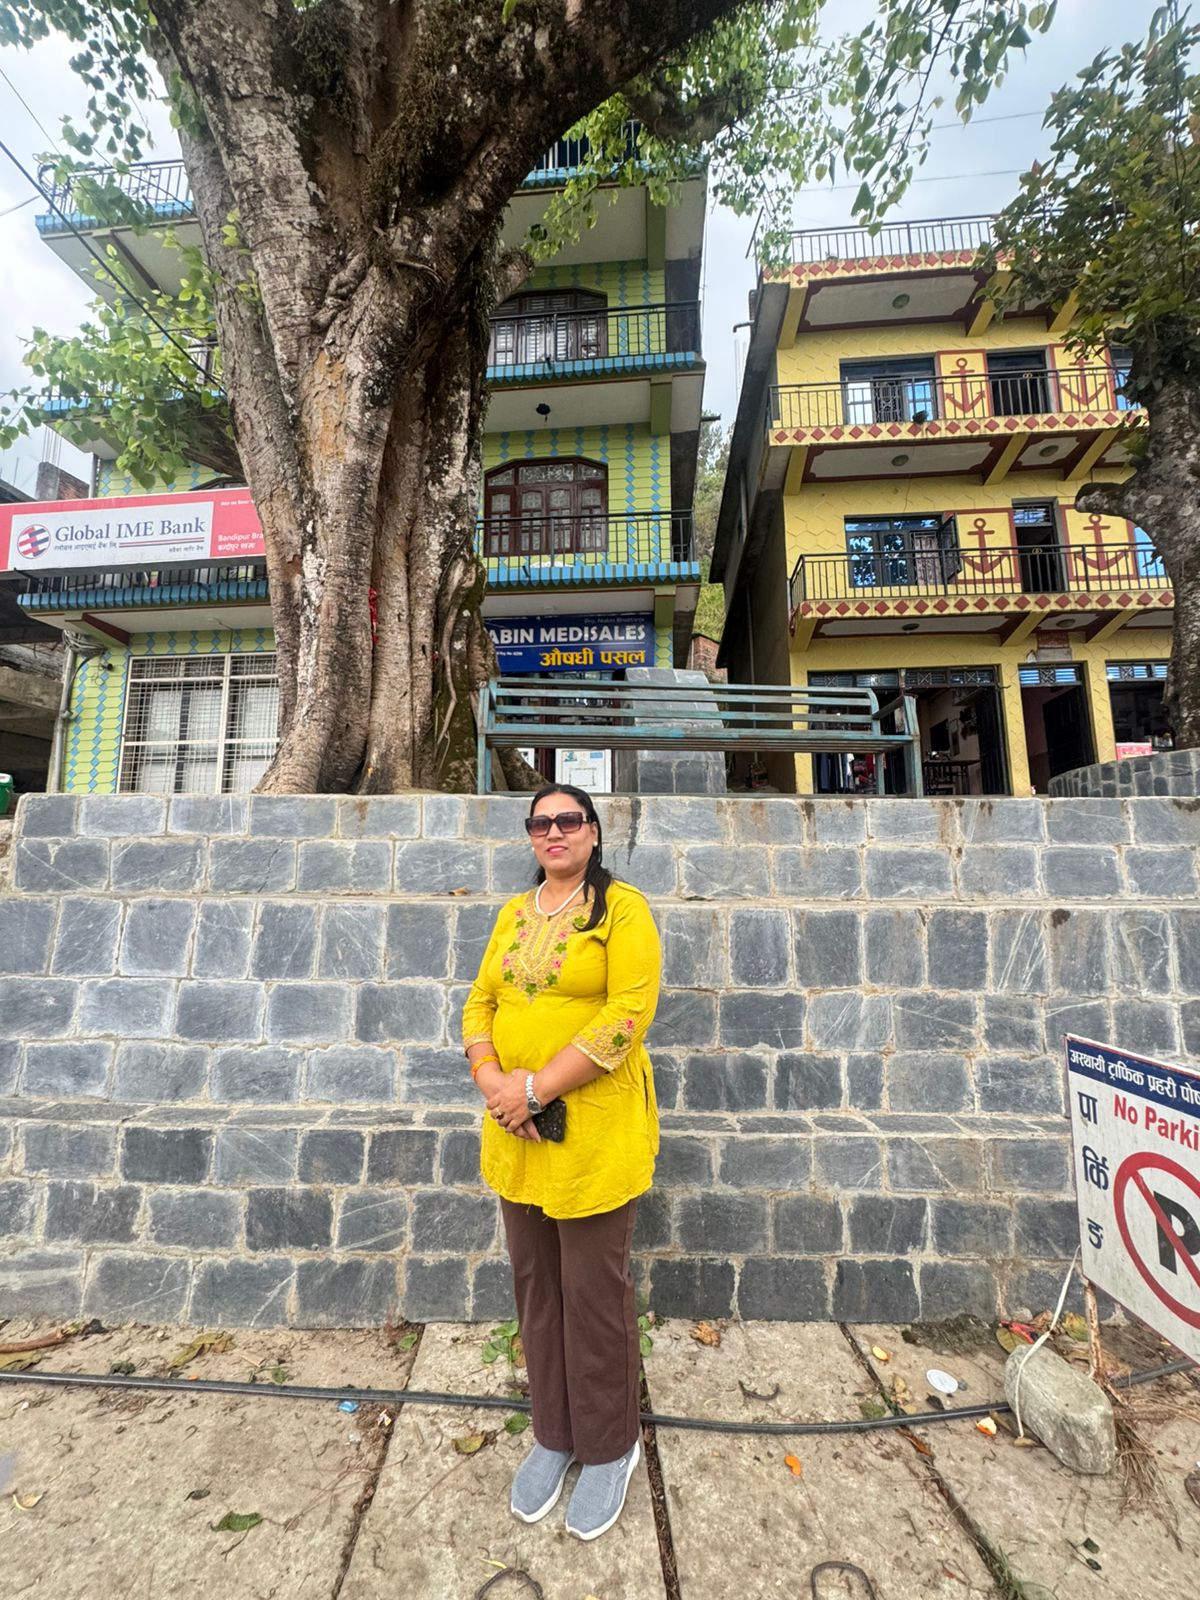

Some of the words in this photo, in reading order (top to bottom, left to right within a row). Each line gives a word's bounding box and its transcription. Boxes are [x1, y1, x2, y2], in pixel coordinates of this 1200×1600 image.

[55, 522, 110, 542] Global
[117, 521, 153, 539] IME
[160, 517, 206, 535] Bank
[218, 533, 250, 542] Bandipur
[488, 628, 535, 645] ABIN
[539, 624, 646, 643] MEDISALES
[539, 647, 595, 667] औषधी
[600, 649, 646, 665] पसल
[1069, 1049, 1105, 1073] अस्थायी
[1107, 1060, 1144, 1086] ट्राफिक
[1147, 1074, 1177, 1098] प्रहरी
[1114, 1093, 1138, 1125] No
[1145, 1105, 1200, 1152] Parki
[1153, 1190, 1200, 1275] P
